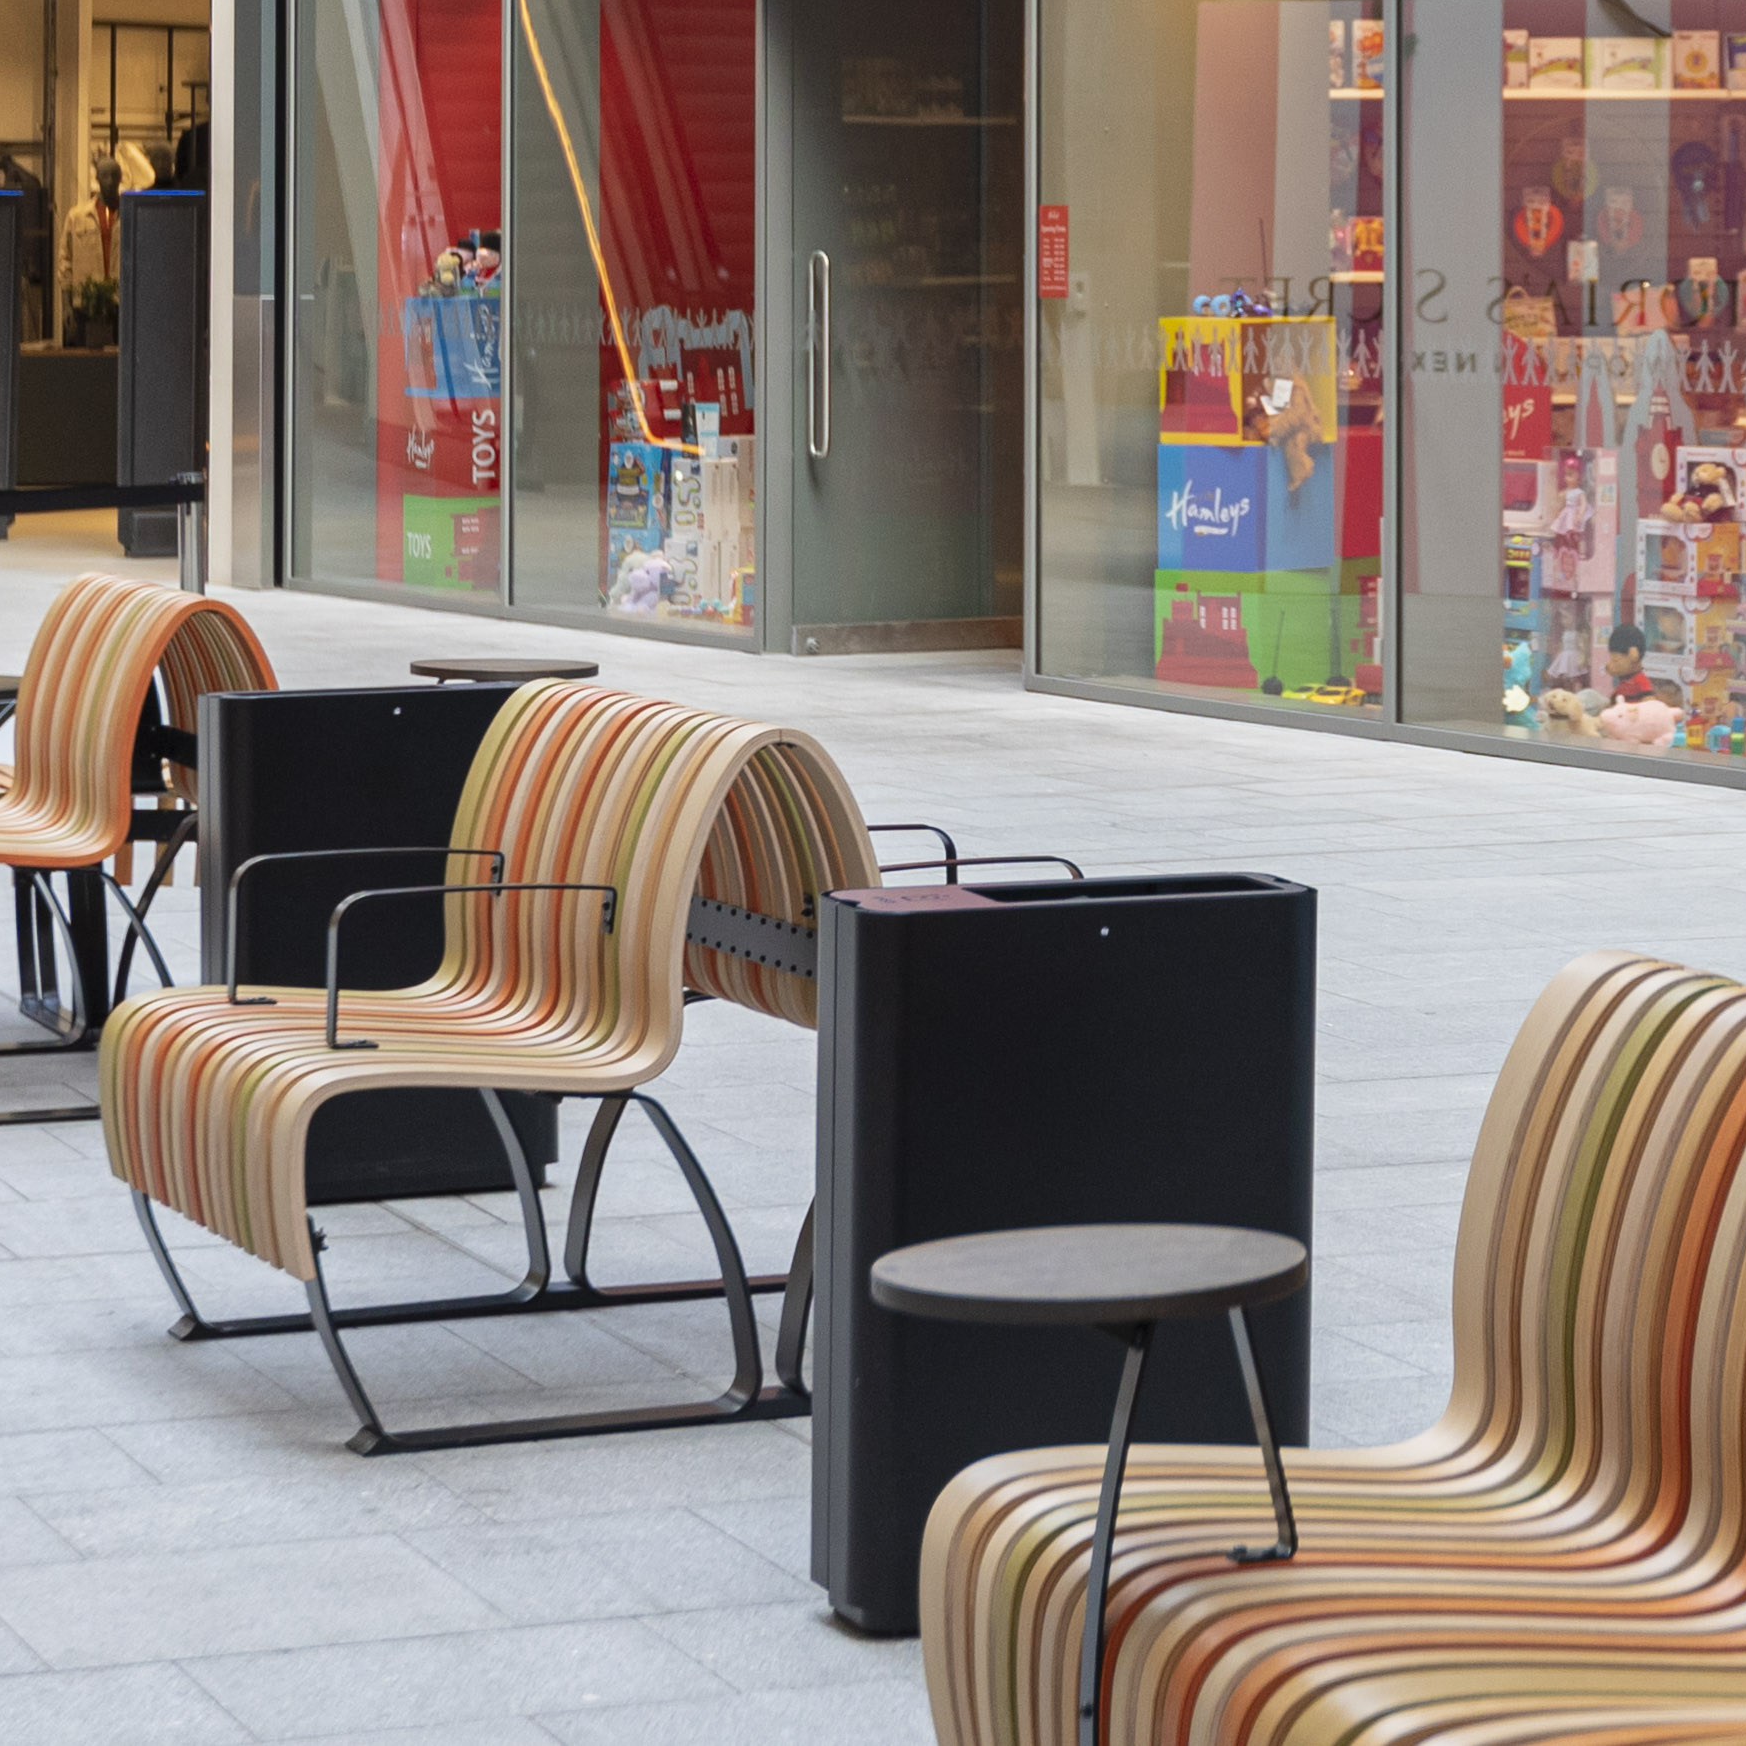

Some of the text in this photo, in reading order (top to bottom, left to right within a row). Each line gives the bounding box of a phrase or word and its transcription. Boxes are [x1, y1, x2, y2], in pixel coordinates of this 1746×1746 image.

[471, 408, 496, 485] TOYS
[1165, 479, 1251, 537] Hamleys
[407, 531, 432, 559] TOYS
